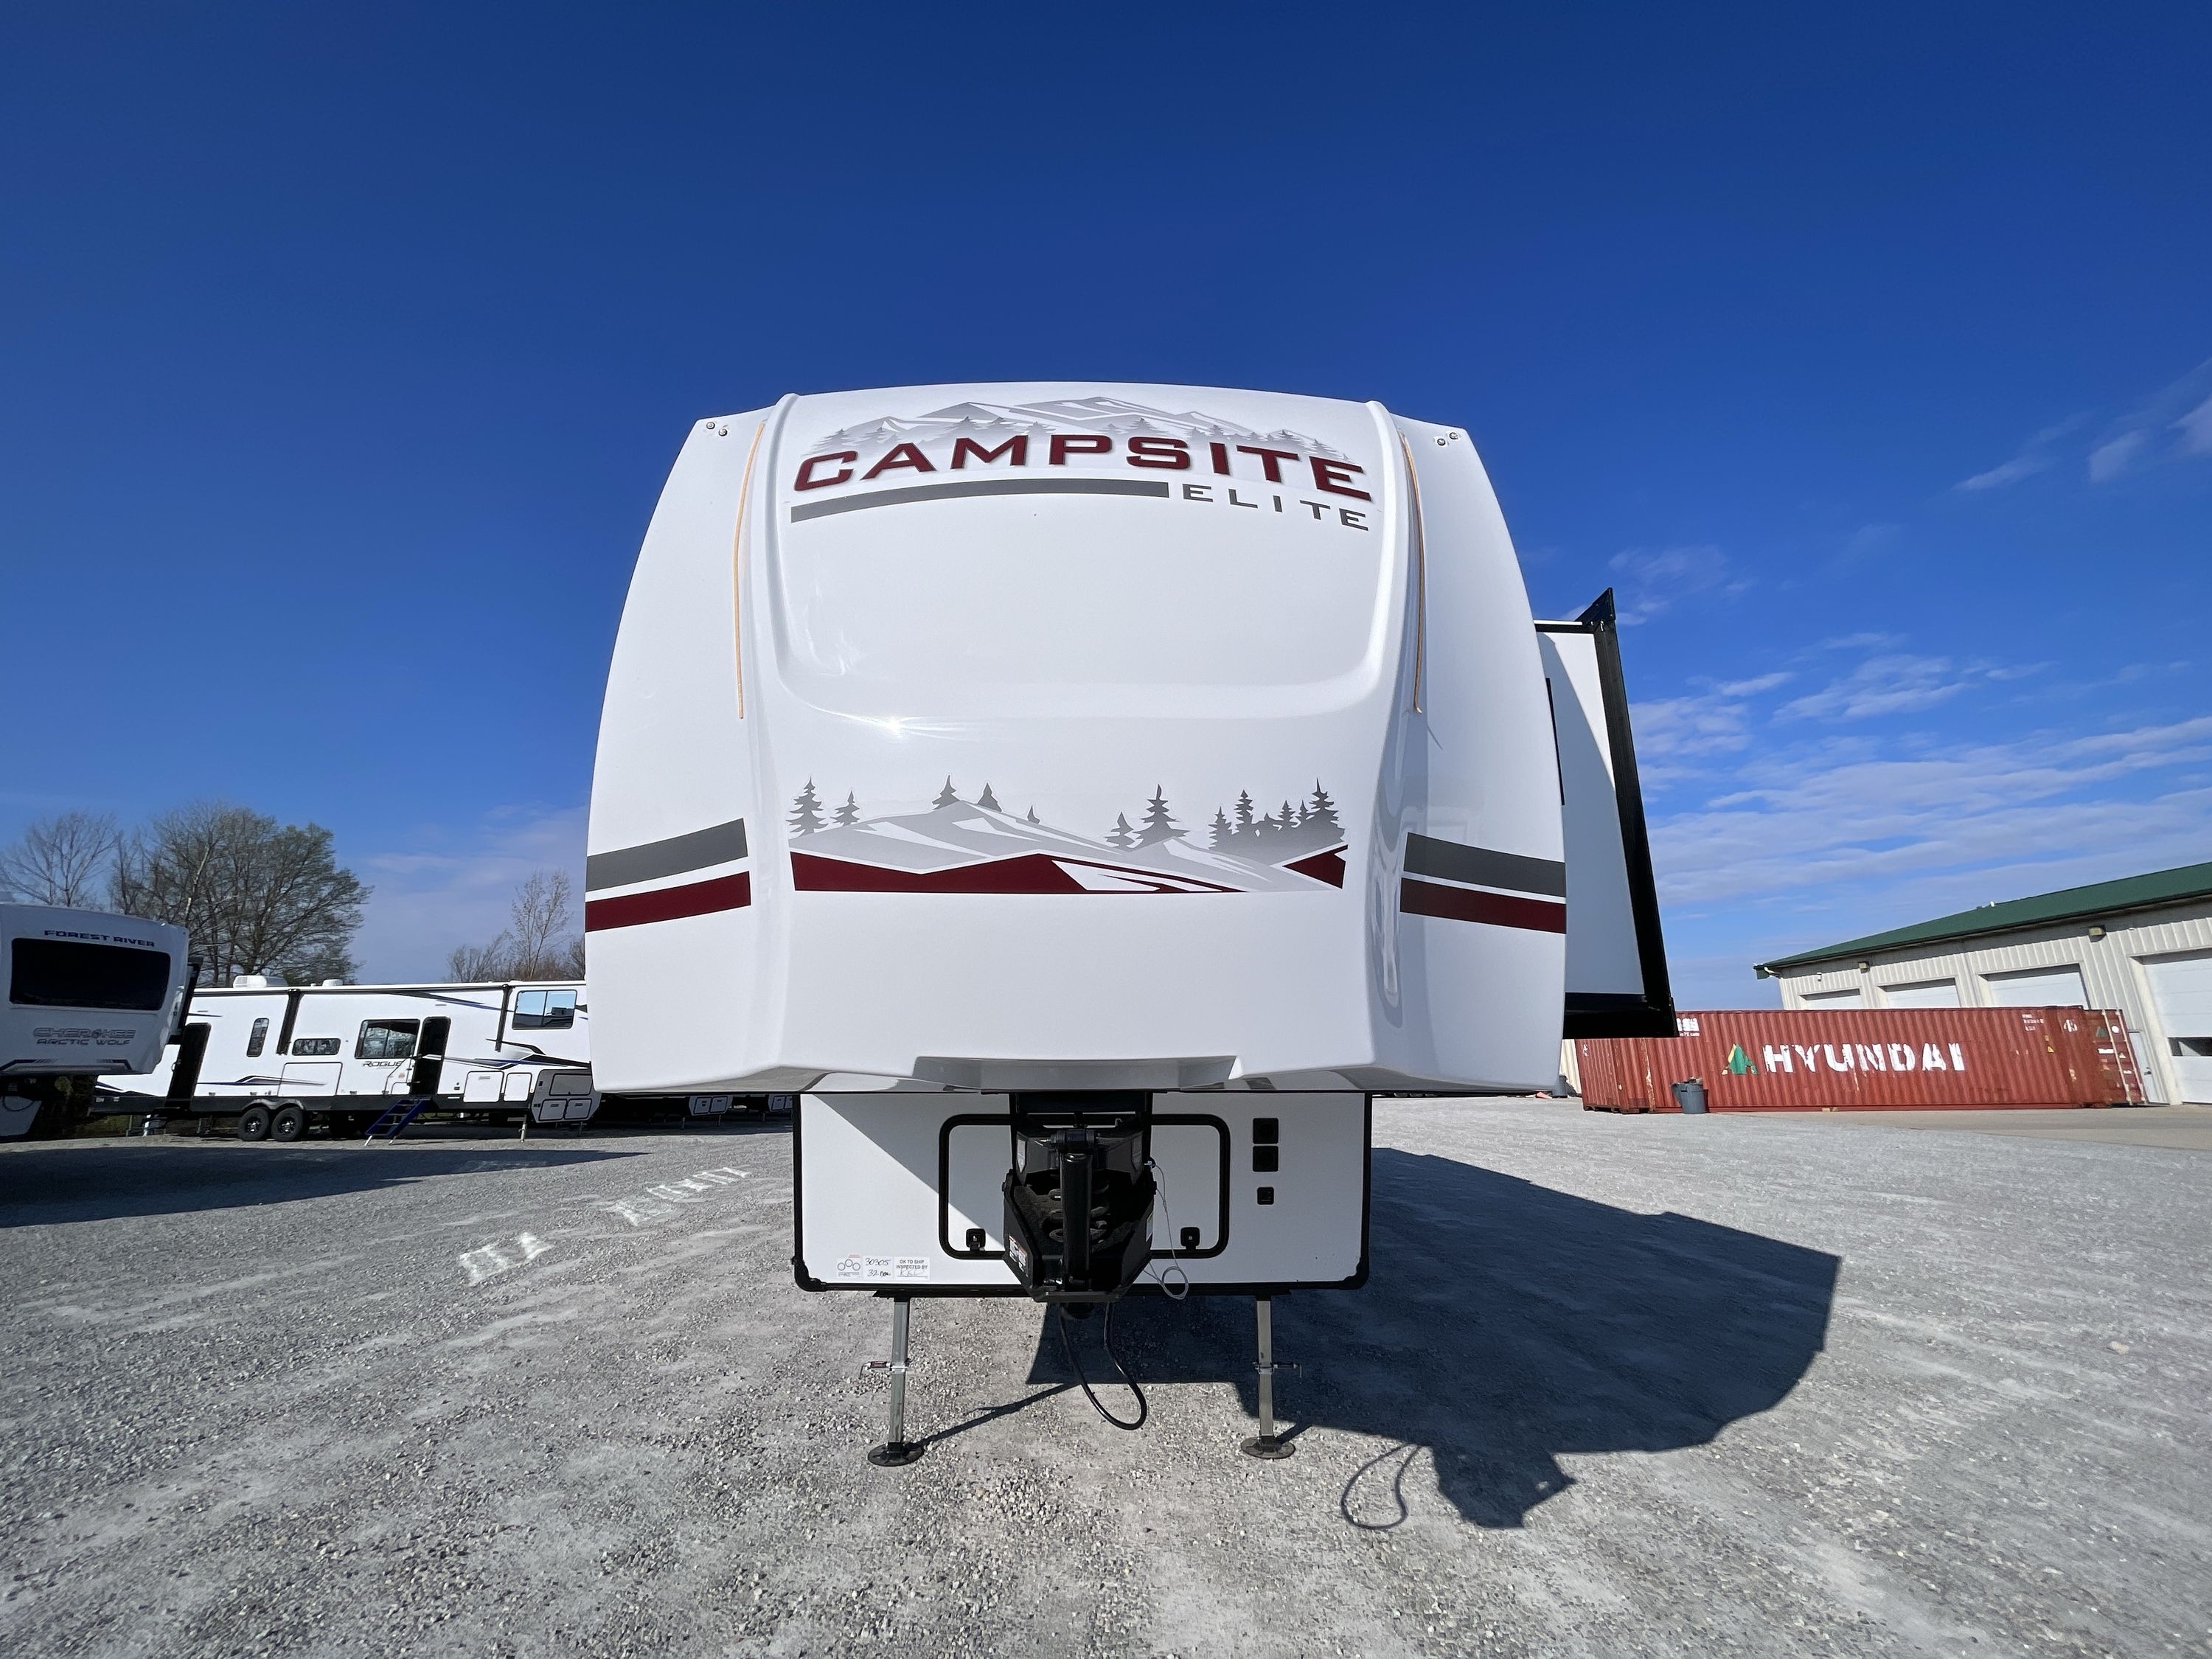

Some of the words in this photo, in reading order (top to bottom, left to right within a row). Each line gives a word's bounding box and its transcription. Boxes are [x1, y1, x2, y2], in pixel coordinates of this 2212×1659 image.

[793, 434, 1371, 501] CAMPSITE
[1182, 483, 1369, 531] ELITE
[44, 930, 110, 941] FOREST
[113, 936, 155, 947] RIVER
[33, 1027, 136, 1038] CHEROKEE
[1762, 1043, 1965, 1073] HYUNDAI
